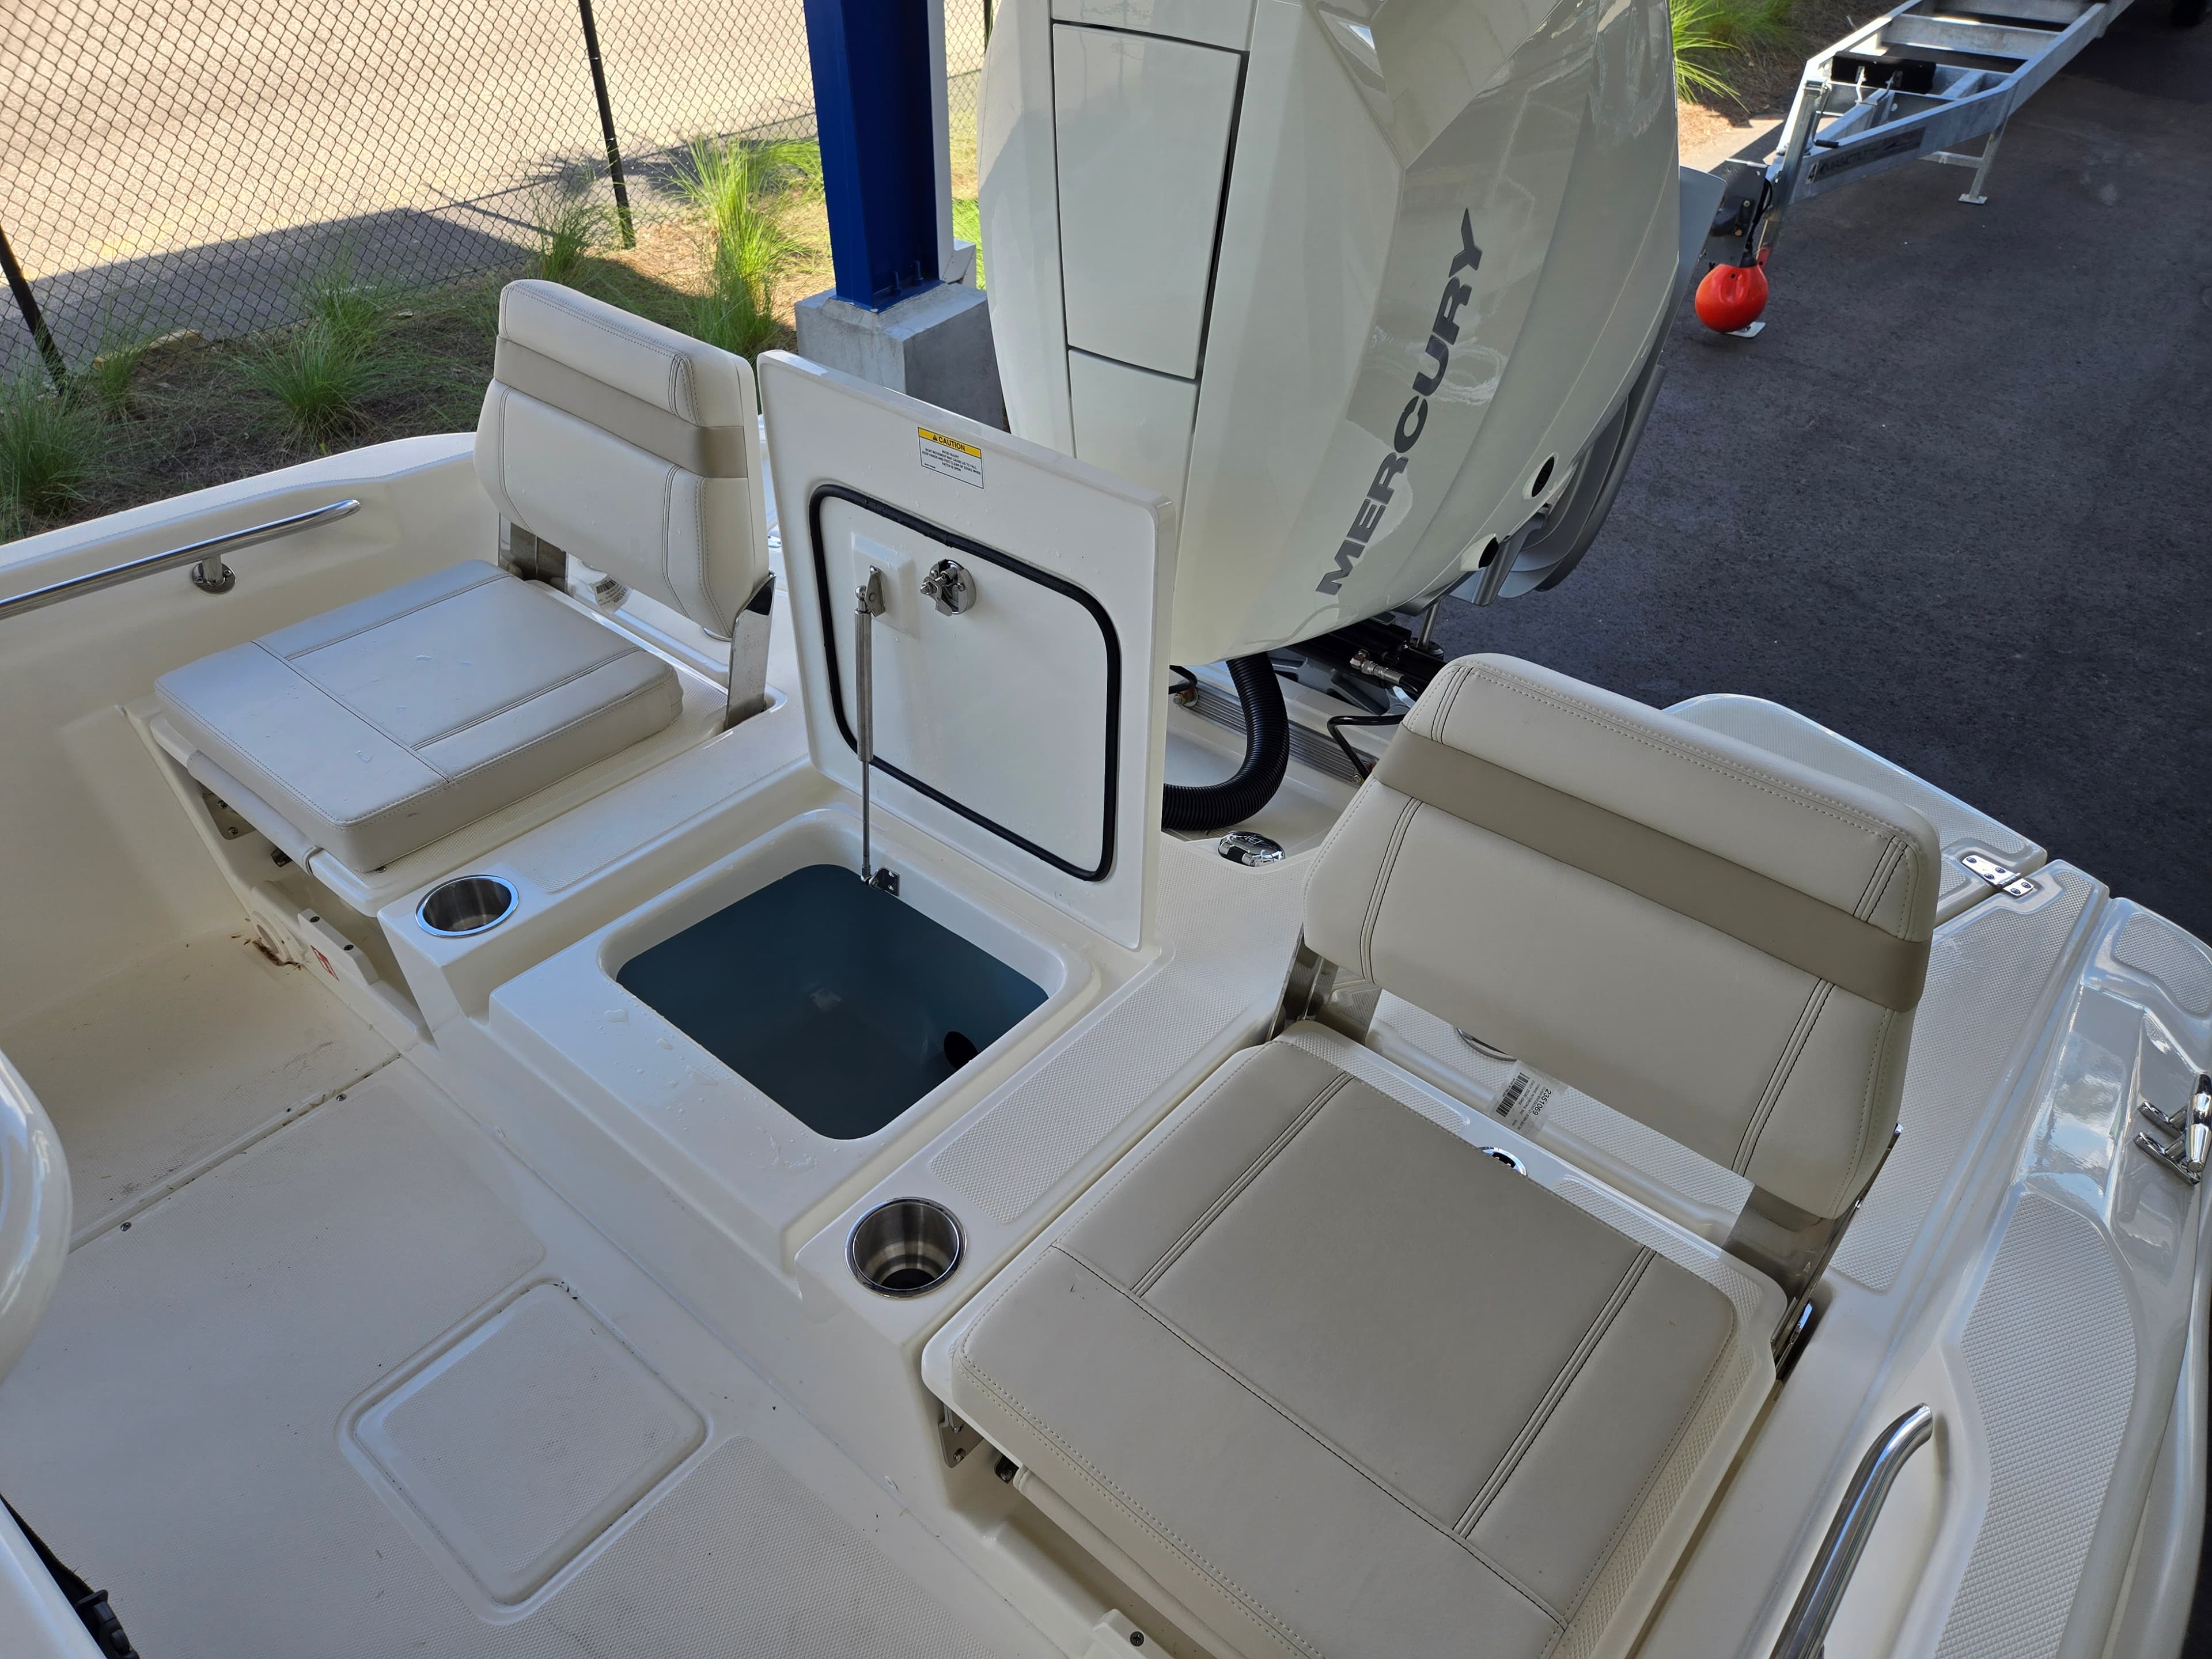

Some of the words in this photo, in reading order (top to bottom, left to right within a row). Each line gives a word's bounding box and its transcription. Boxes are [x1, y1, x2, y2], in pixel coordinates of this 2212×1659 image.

[1315, 207, 1483, 596] MERCURY
[939, 437, 965, 451] CAUTION
[1532, 1088, 1551, 1116] 2351069
